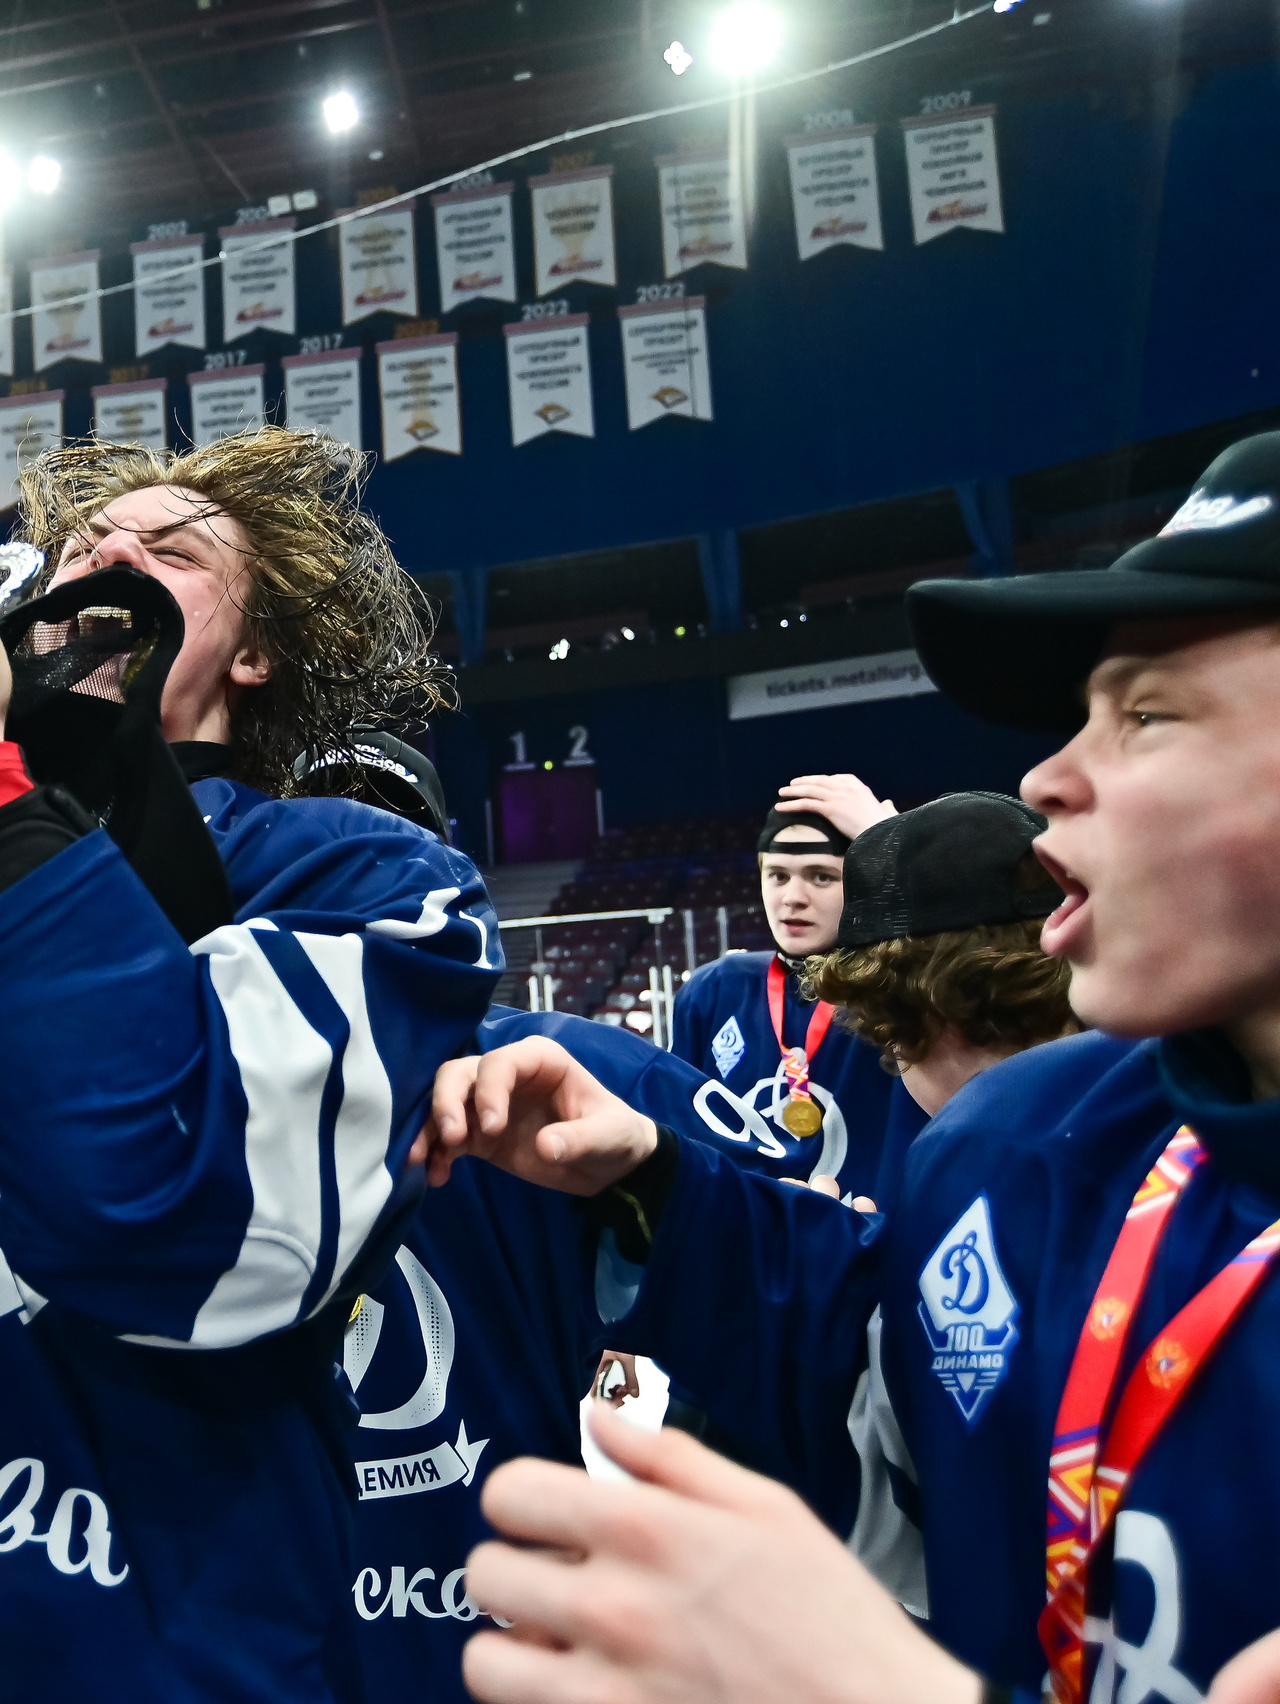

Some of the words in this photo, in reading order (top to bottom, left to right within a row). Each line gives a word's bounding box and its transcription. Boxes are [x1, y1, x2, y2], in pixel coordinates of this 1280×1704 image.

[569, 725, 589, 759] 2
[946, 1325, 984, 1352] 100
[931, 1353, 1004, 1370] ДИНАМО
[359, 1456, 441, 1497] ЕМИЯ
